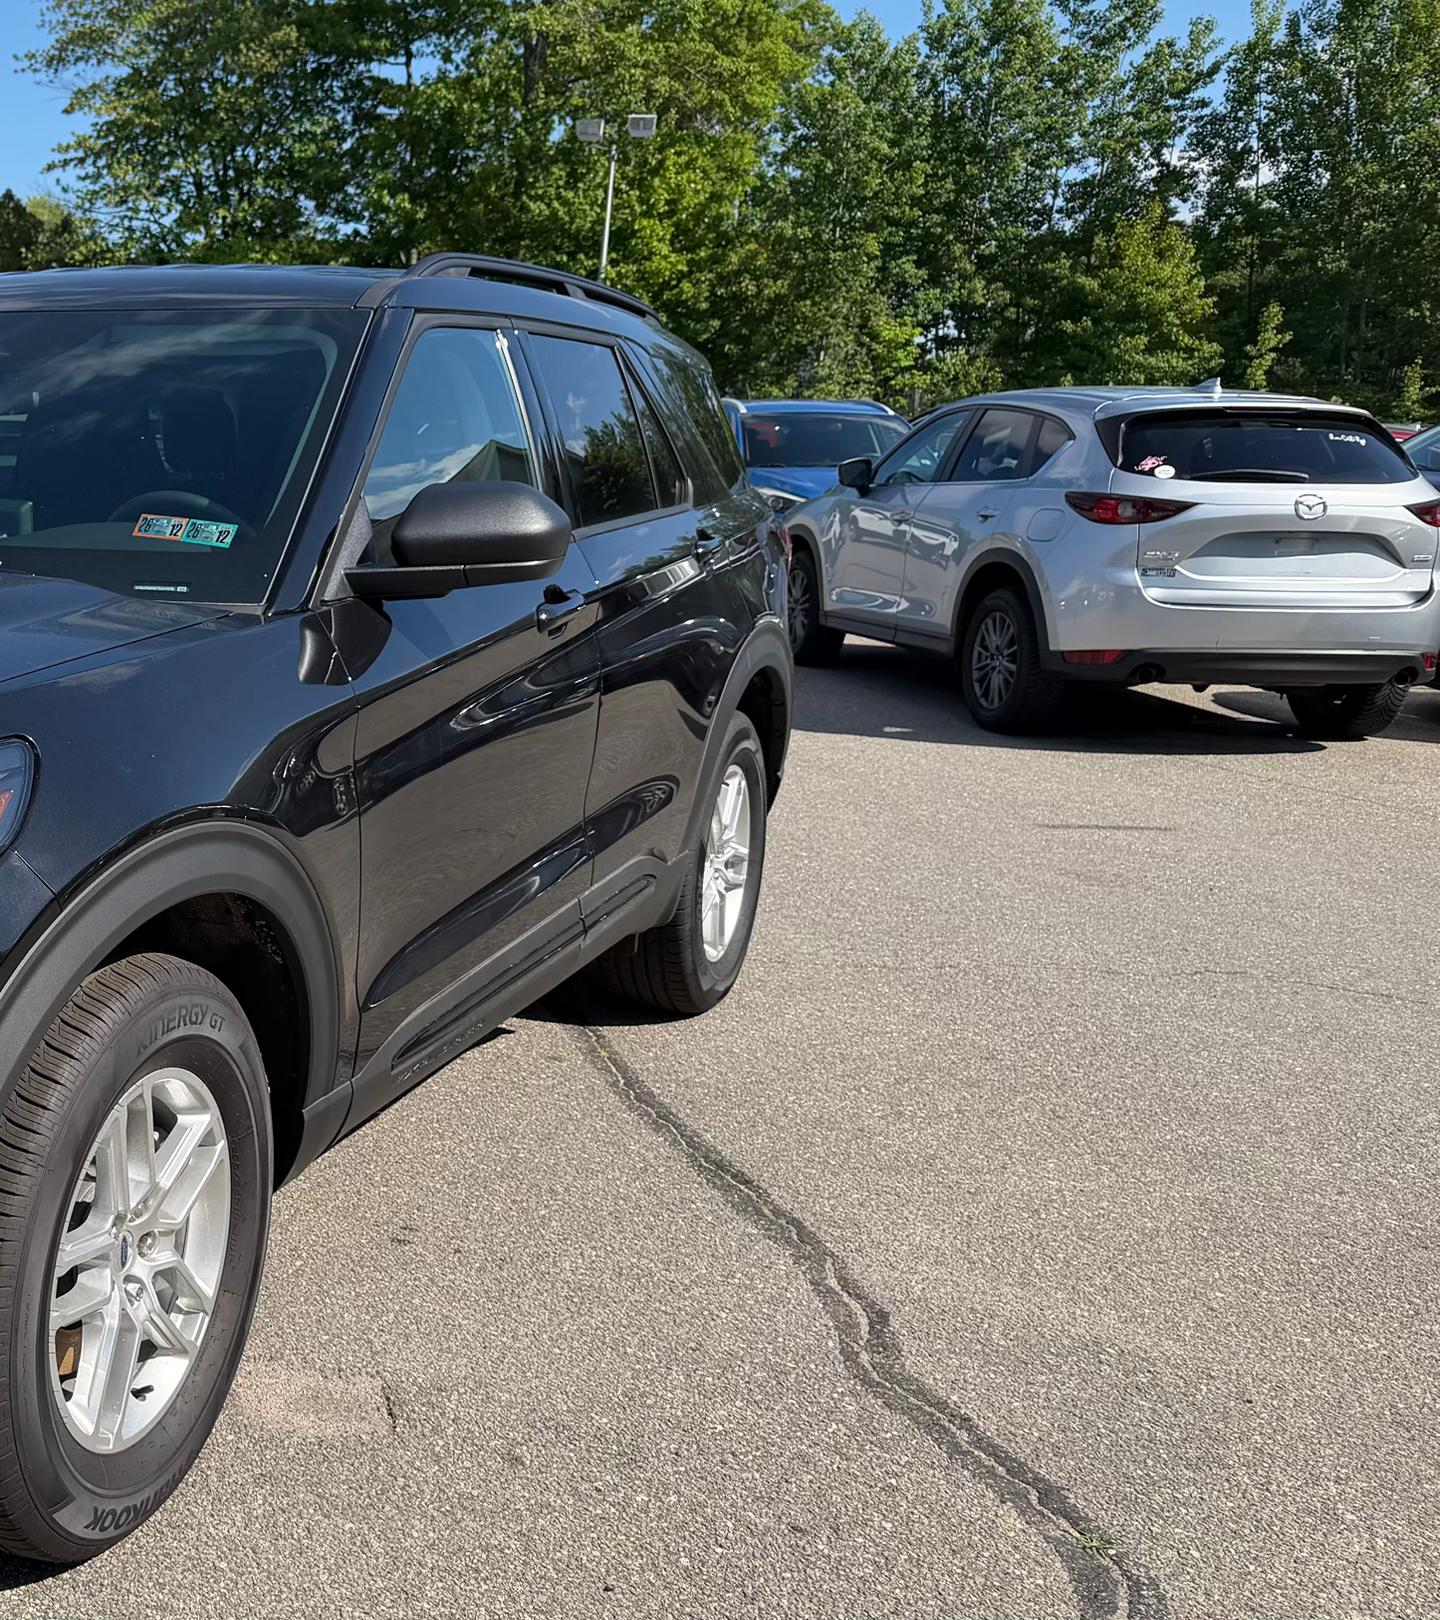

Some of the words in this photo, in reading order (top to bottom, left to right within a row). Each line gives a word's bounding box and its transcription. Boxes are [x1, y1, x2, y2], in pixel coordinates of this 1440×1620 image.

[140, 517, 155, 533] 26
[169, 523, 183, 537] 12
[187, 522, 201, 539] 26
[215, 529, 231, 544] 12
[209, 1012, 226, 1032] GT
